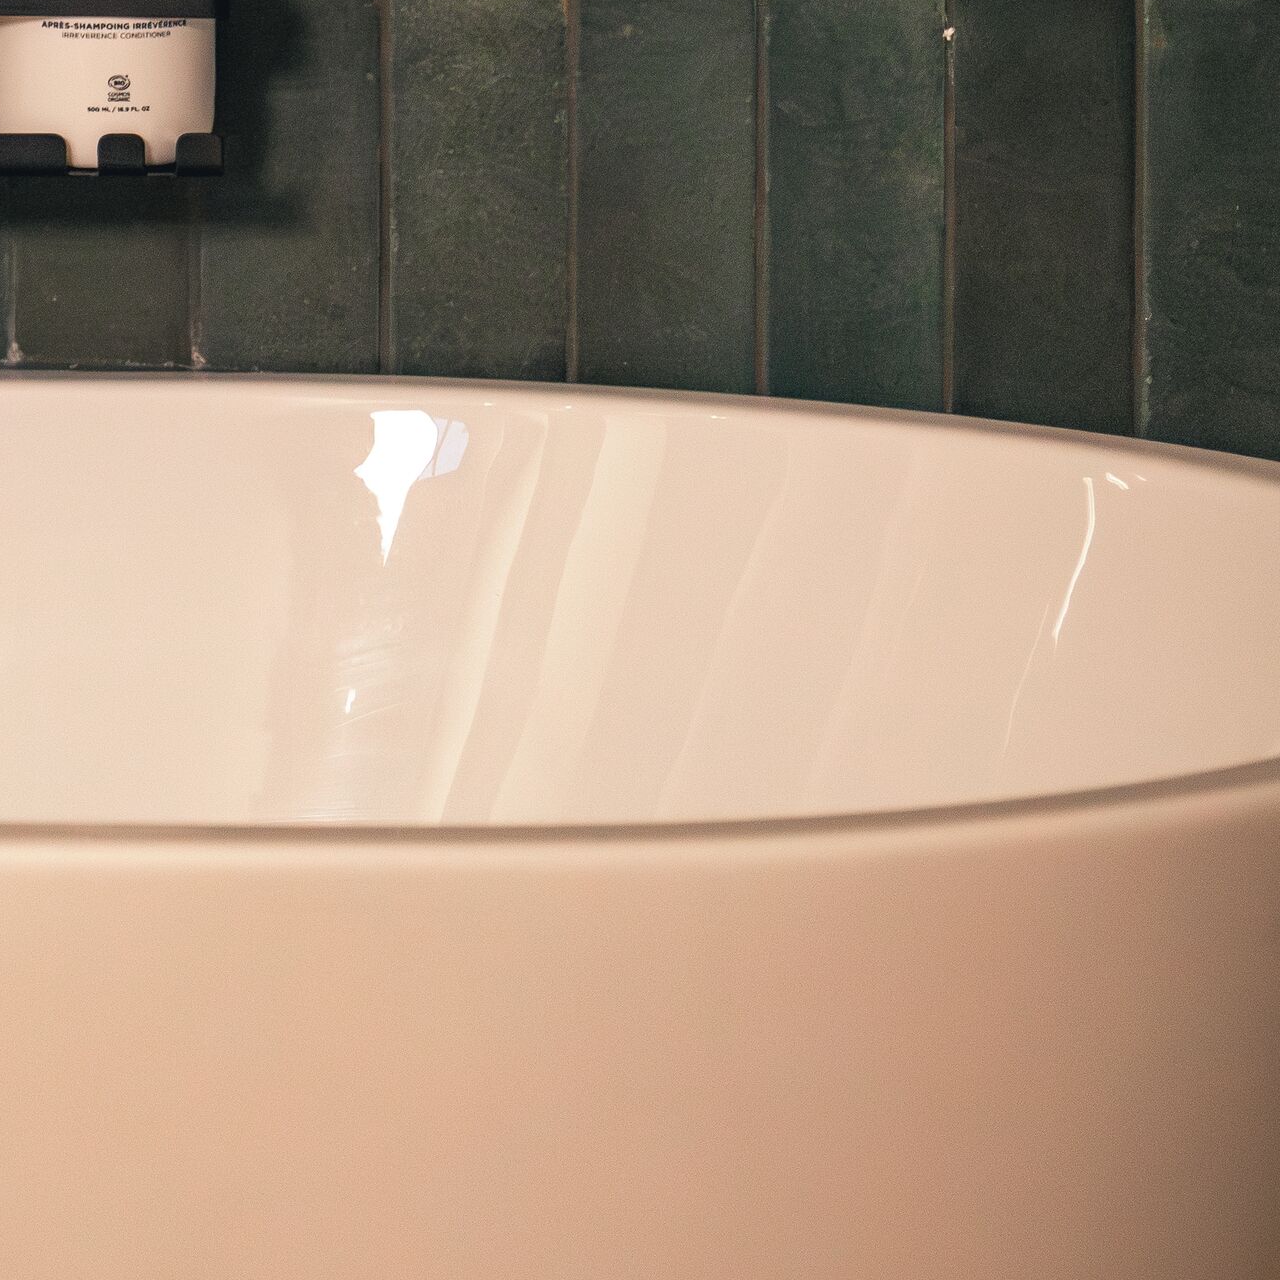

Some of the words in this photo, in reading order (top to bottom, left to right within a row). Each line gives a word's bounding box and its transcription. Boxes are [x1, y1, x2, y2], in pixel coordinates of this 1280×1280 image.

[41, 19, 130, 31] APRÈS-SHAMPOING
[132, 19, 188, 30] IRRÉVÉRENCE
[61, 31, 118, 40] IRREVERENCE
[119, 30, 171, 40] CONDITIONER
